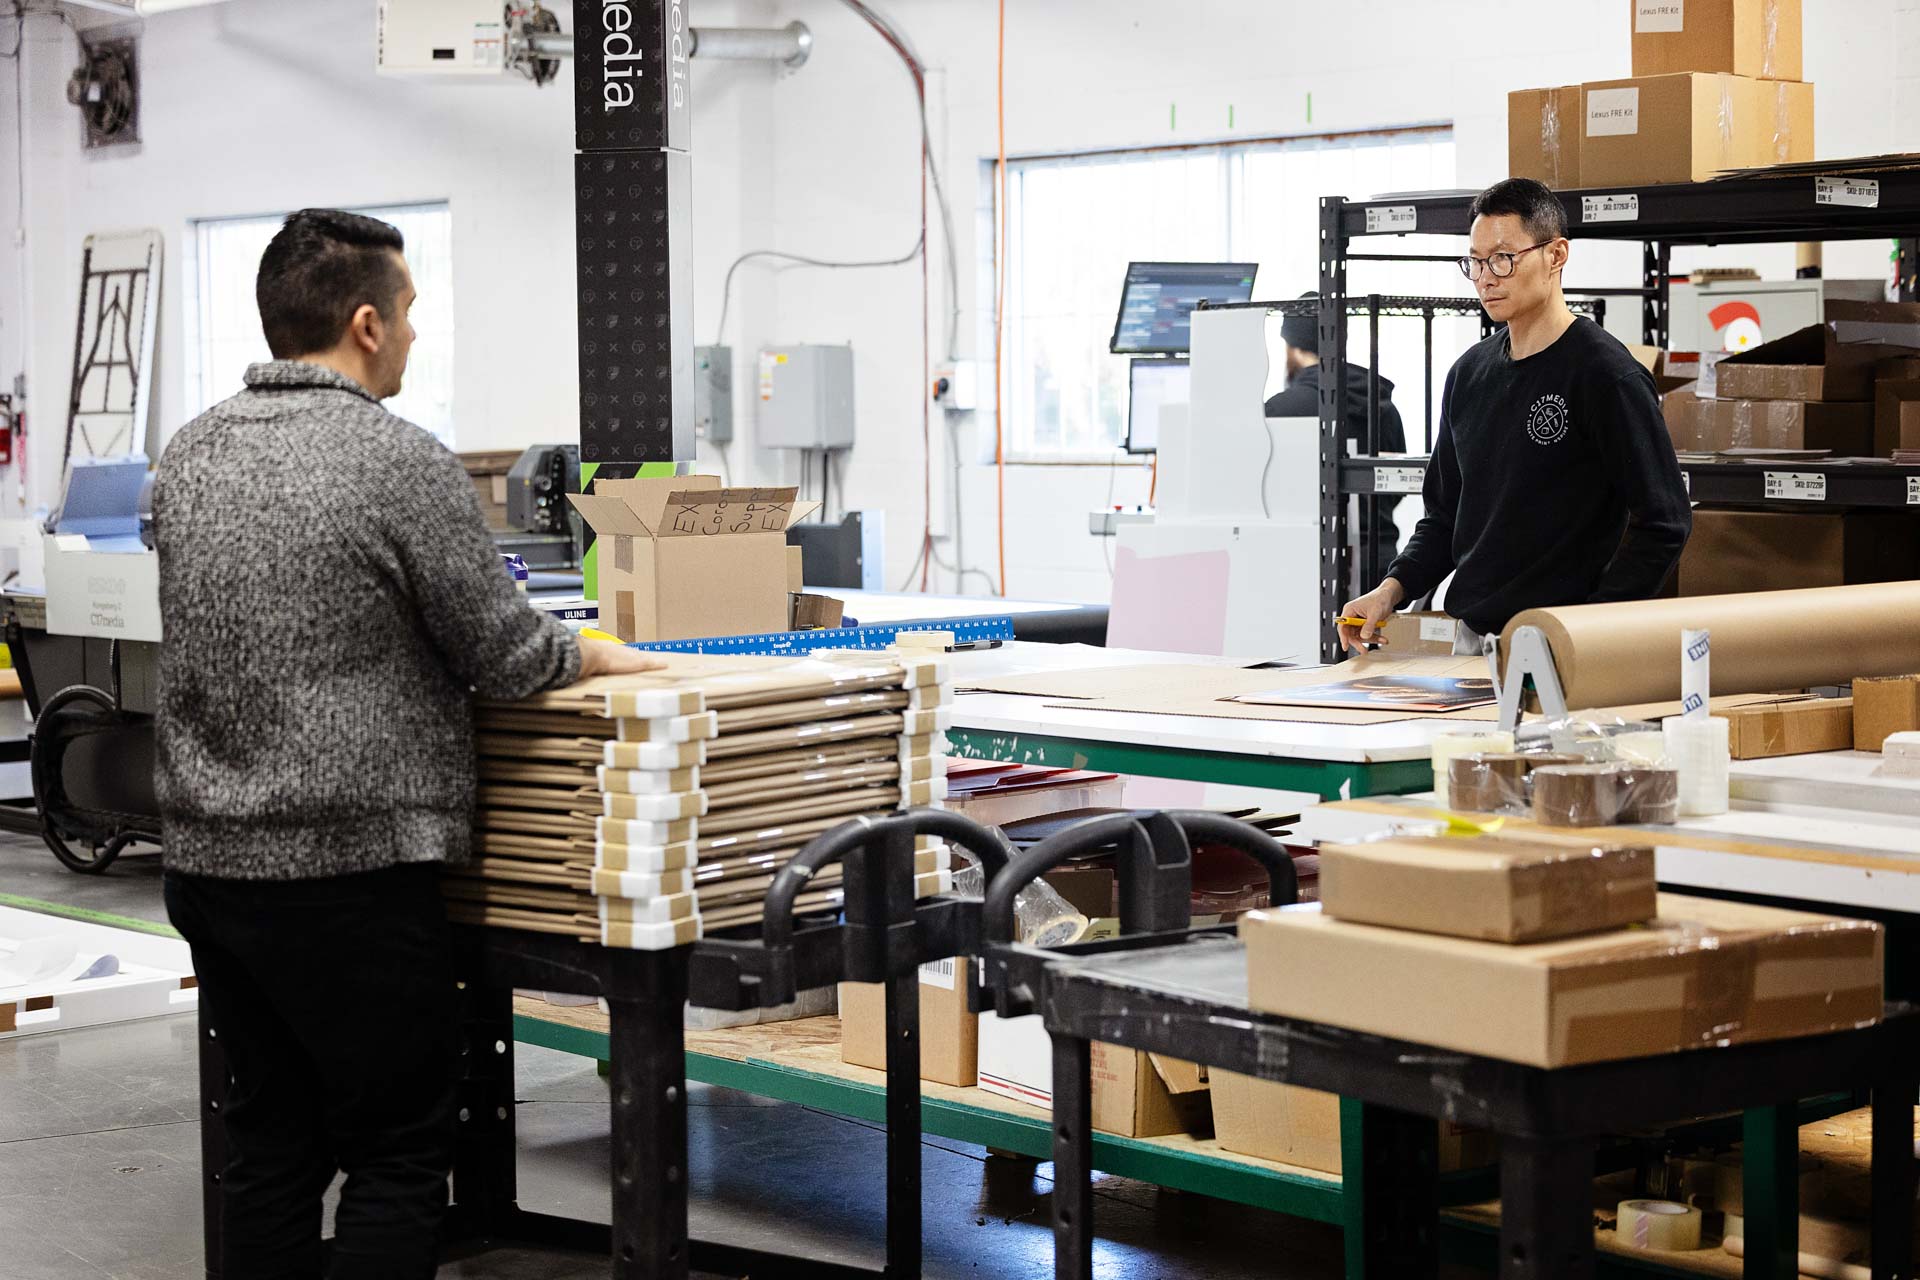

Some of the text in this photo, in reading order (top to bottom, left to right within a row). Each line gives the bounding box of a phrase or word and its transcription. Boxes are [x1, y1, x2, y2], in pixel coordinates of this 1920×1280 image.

[1640, 7, 1656, 15] Lexus
[1657, 6, 1669, 15] FRE
[1611, 109, 1622, 117] FRE
[1624, 109, 1632, 117] Kit
[730, 487, 766, 532] Supp
[564, 610, 587, 619] ULINE
